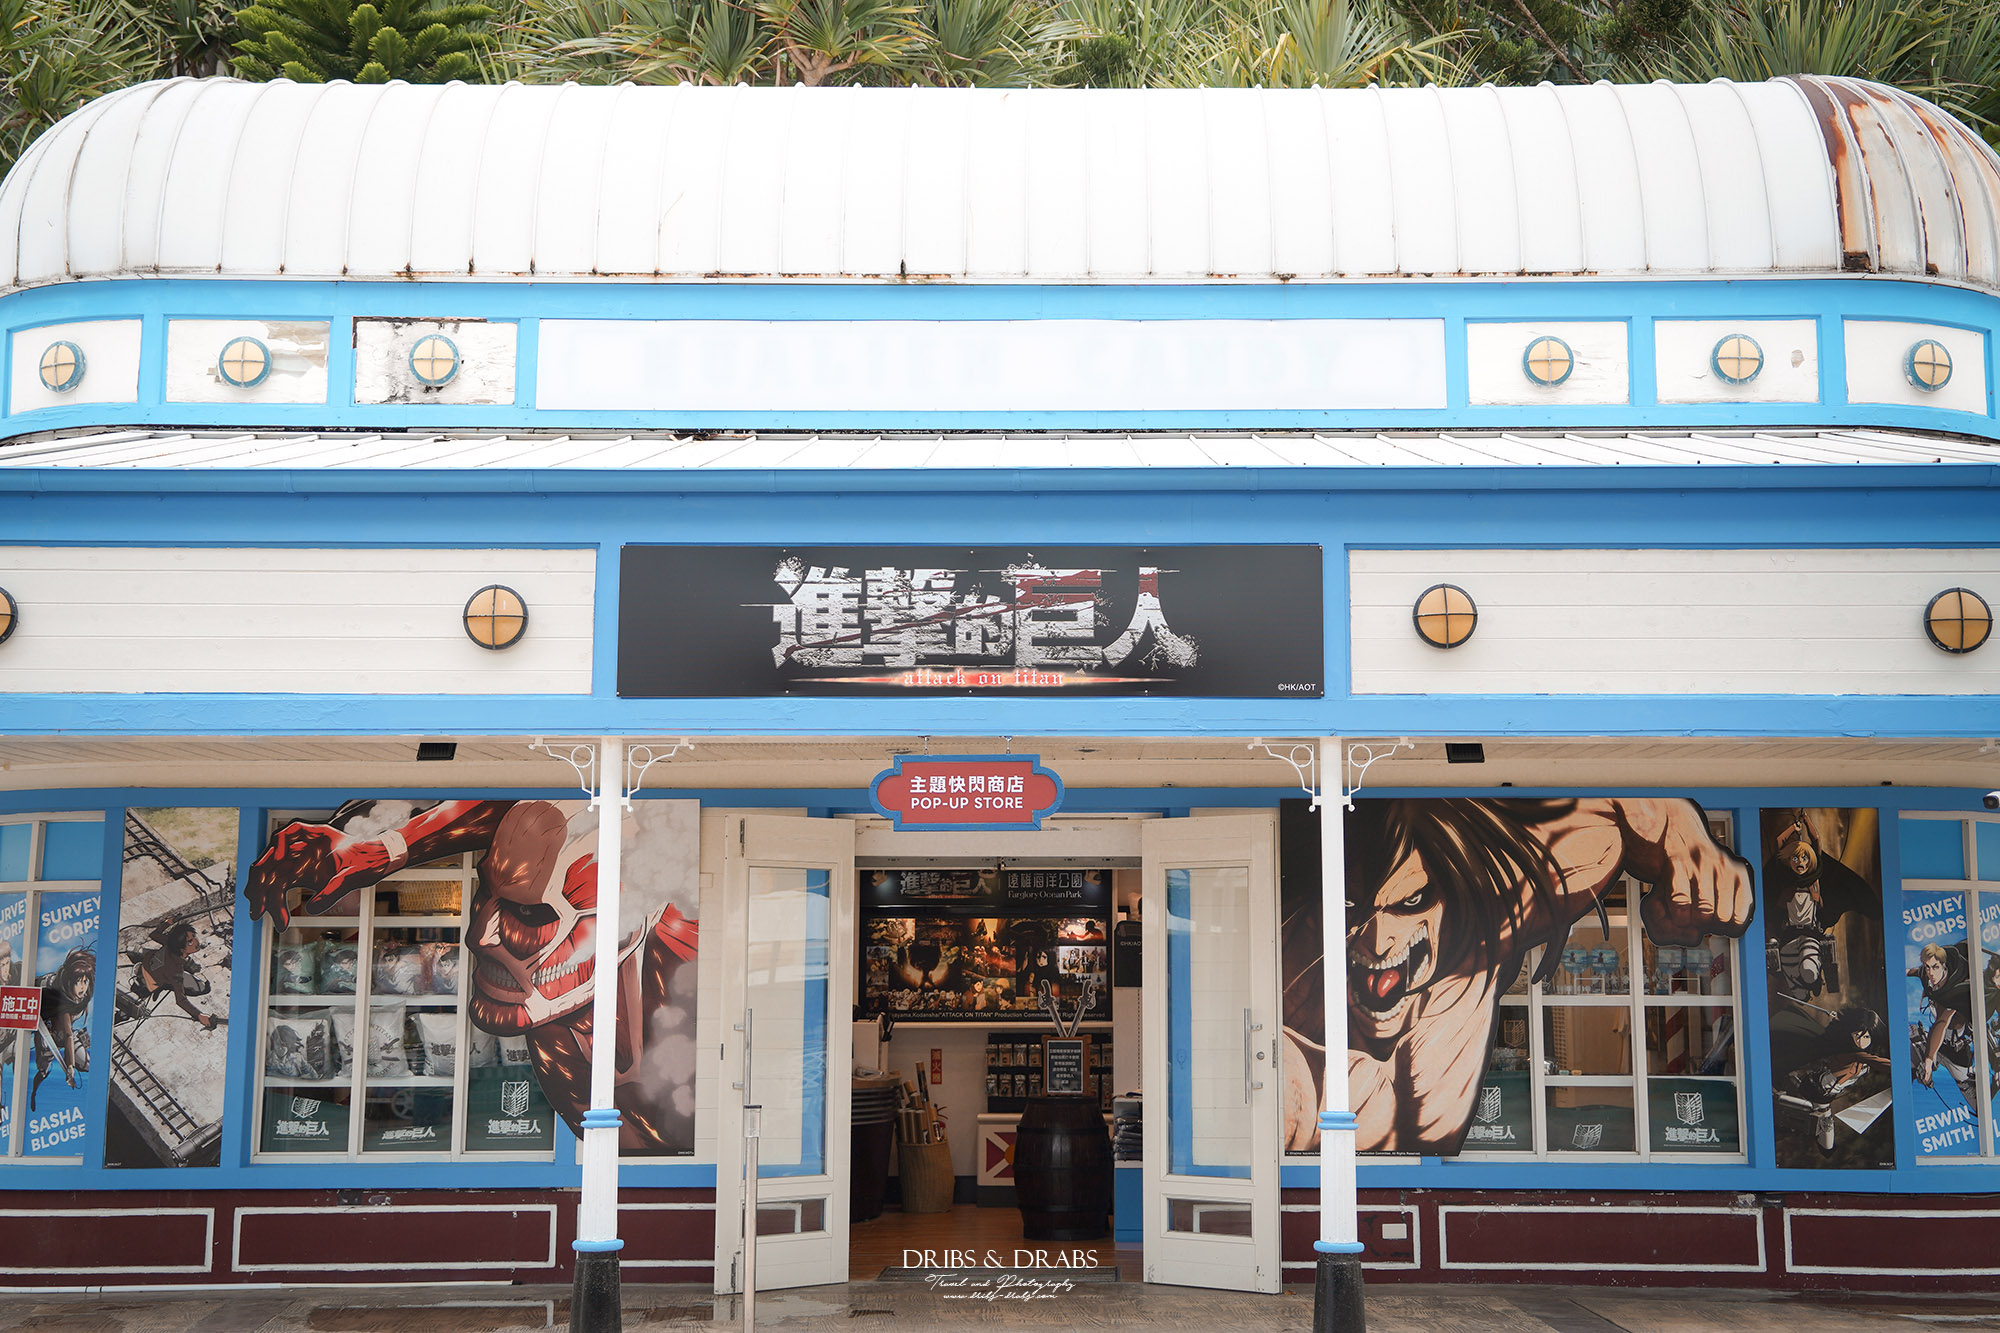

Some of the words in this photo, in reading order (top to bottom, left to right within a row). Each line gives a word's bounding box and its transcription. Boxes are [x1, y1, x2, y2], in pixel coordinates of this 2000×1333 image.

[904, 669, 966, 685] attack
[978, 671, 1002, 685] on
[1014, 669, 1063, 685] titan
[909, 775, 1024, 793] 主題快閃商店
[911, 797, 969, 809] POP-UP
[974, 797, 1023, 809] STORE
[1008, 891, 1038, 900] Farglory
[41, 896, 101, 927] SURVEY
[1902, 895, 1963, 925] SURVEY
[48, 915, 100, 944] CORPS
[1911, 914, 1967, 942] CORPS
[2, 995, 38, 1013] 施工中
[29, 1106, 84, 1135] SASHA
[1915, 1105, 1971, 1135] ERWIN
[31, 1123, 86, 1152] BLOUSE
[1922, 1125, 1975, 1153] SMITH
